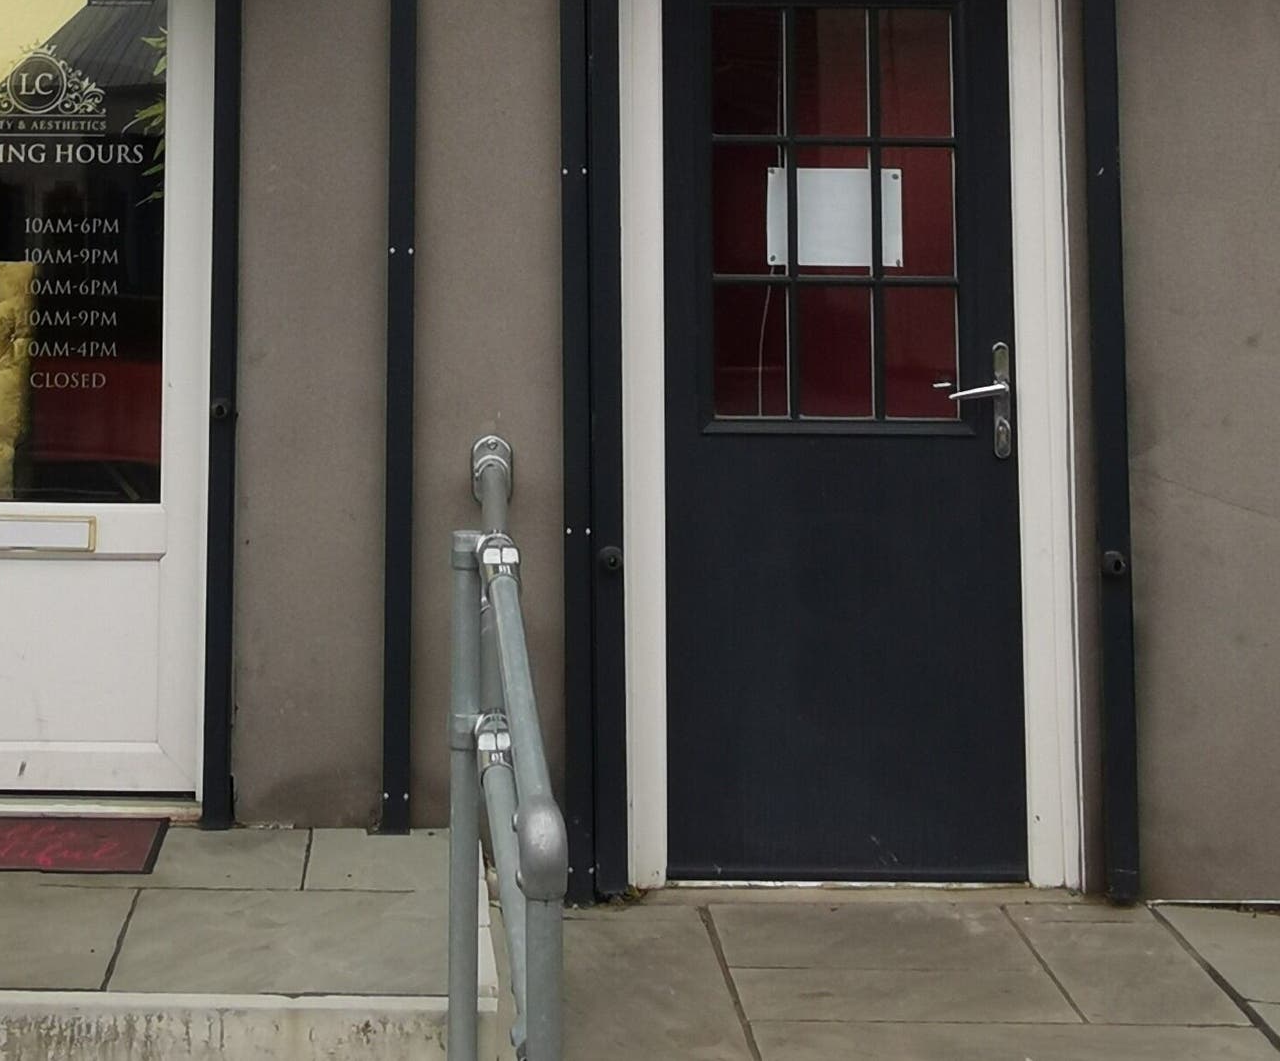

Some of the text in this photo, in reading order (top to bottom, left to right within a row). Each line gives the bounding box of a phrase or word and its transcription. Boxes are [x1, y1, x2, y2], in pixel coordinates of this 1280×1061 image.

[20, 73, 54, 96] LC
[18, 120, 26, 130] &
[31, 119, 107, 131] AESTHETICS
[55, 143, 144, 164] HOURS
[24, 217, 120, 235] 10AM-6PM
[24, 247, 119, 265] 10AM-9PM
[28, 340, 118, 358] 0AM-4PM
[29, 371, 106, 389] CLOSED
